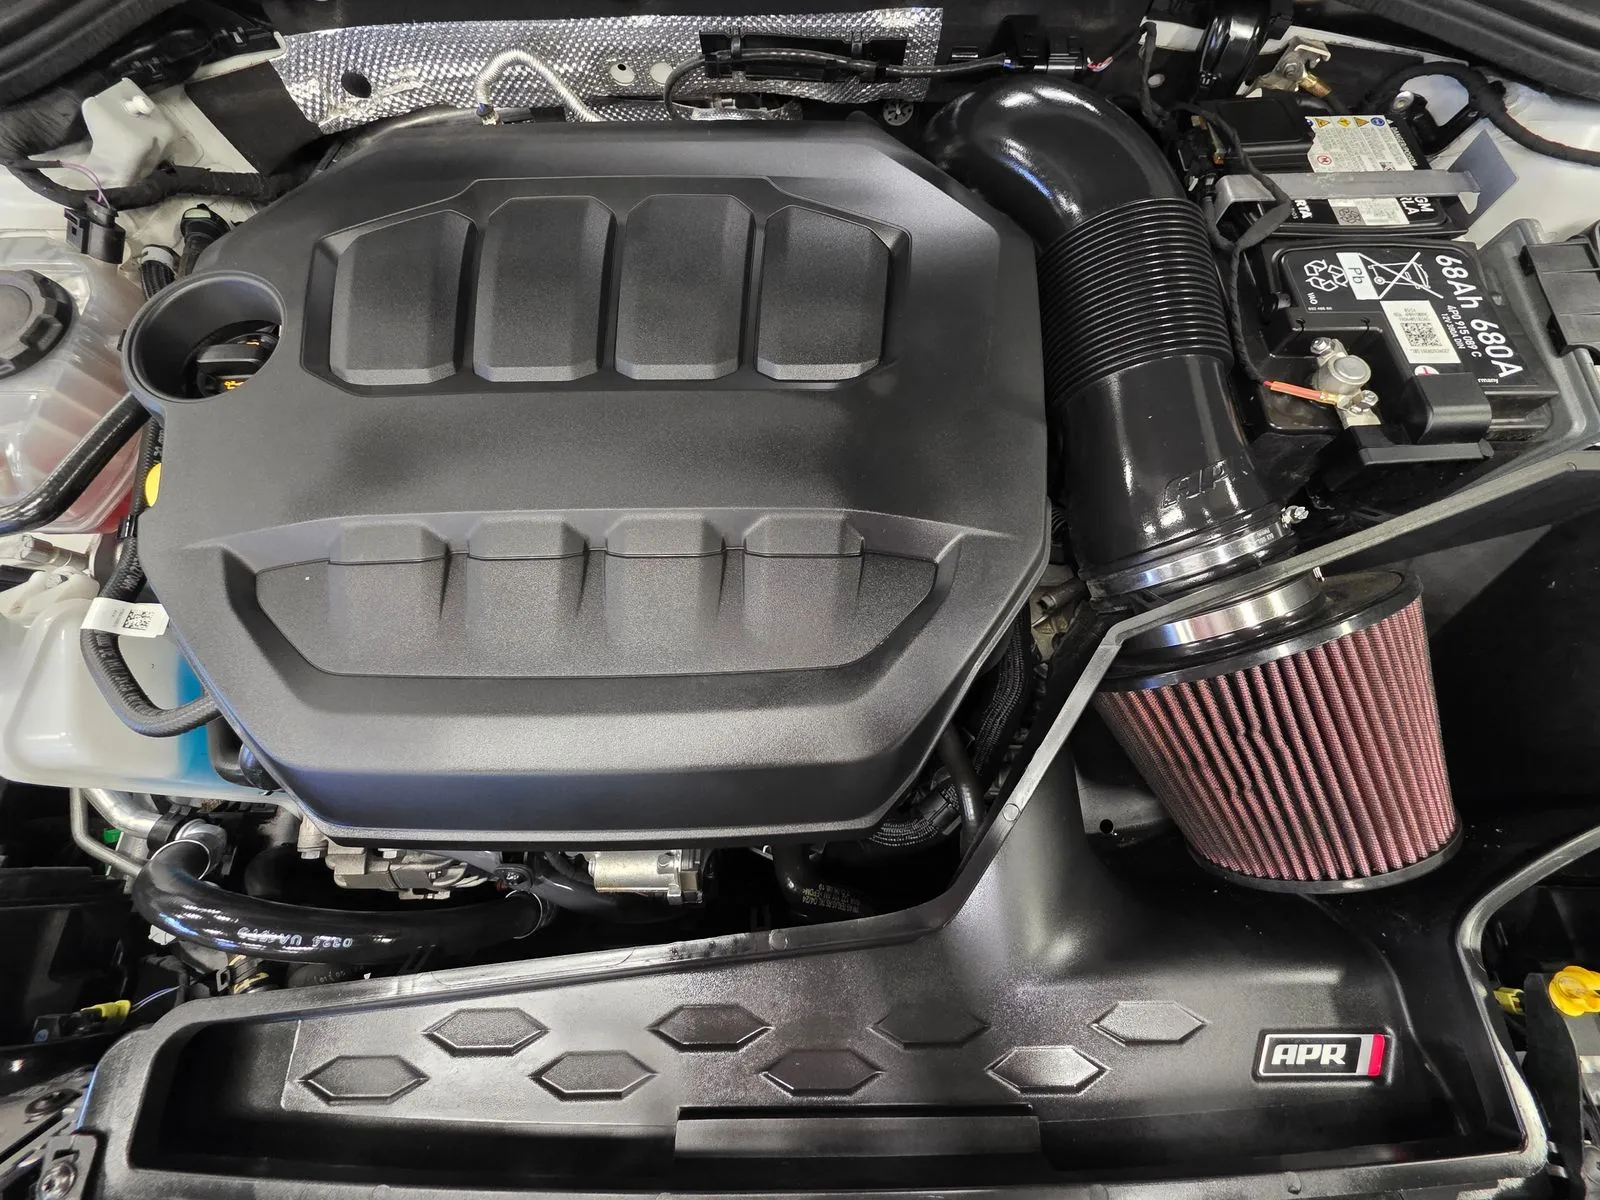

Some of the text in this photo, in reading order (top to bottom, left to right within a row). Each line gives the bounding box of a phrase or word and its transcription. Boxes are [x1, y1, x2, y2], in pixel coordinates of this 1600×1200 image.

[1295, 199, 1313, 219] RTA
[1400, 196, 1420, 215] RLA
[1414, 196, 1435, 212] GM
[1348, 267, 1364, 284] Pb
[1435, 254, 1523, 378] 68Ah 680A
[1455, 320, 1470, 335] 915
[1471, 350, 1482, 358] C
[1271, 1044, 1346, 1065] APR
